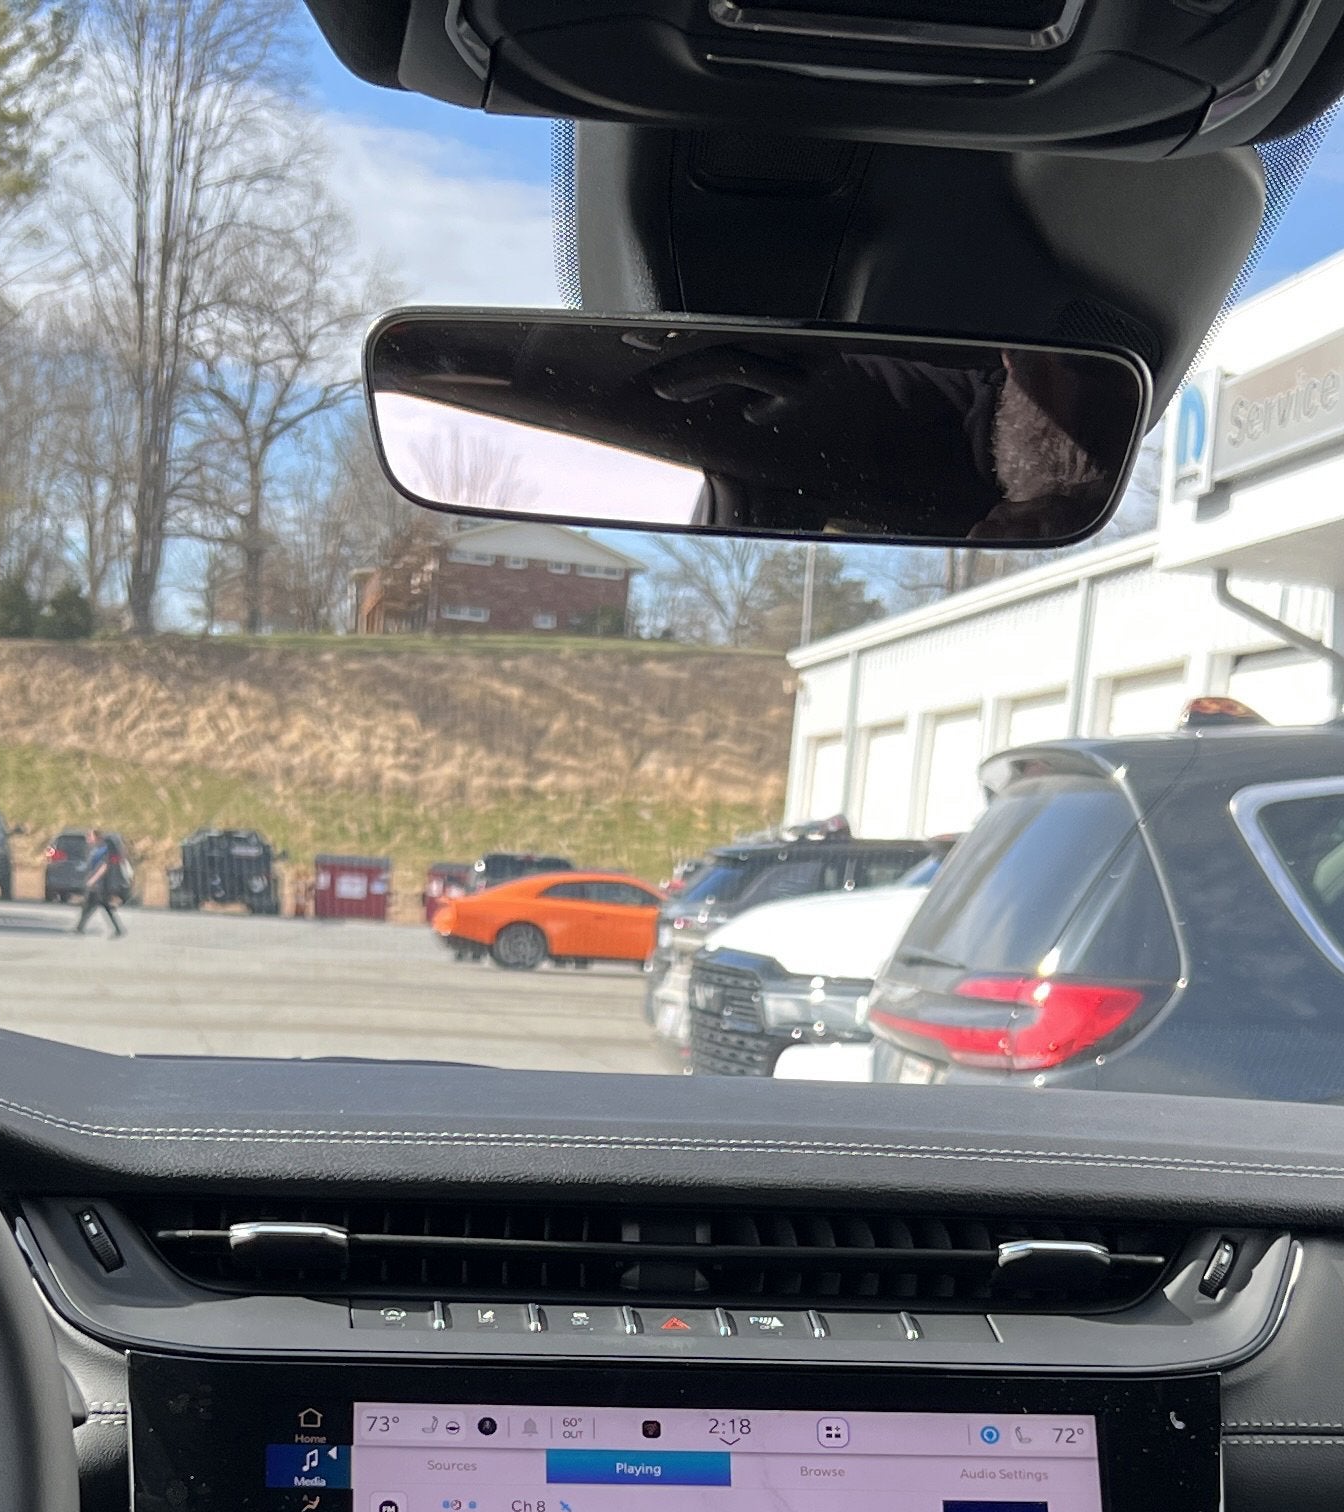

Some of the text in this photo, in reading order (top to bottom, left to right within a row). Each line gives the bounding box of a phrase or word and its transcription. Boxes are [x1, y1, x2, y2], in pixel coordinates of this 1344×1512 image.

[1226, 366, 1340, 447] Service
[708, 1418, 752, 1435] 2:18
[294, 1433, 327, 1444] Home
[562, 1430, 584, 1440] OUT
[426, 1459, 478, 1472] Sources
[615, 1462, 662, 1478] Playing
[800, 1465, 846, 1478] Browse
[959, 1468, 1049, 1482] Audio Settings
[293, 1476, 327, 1488] Media
